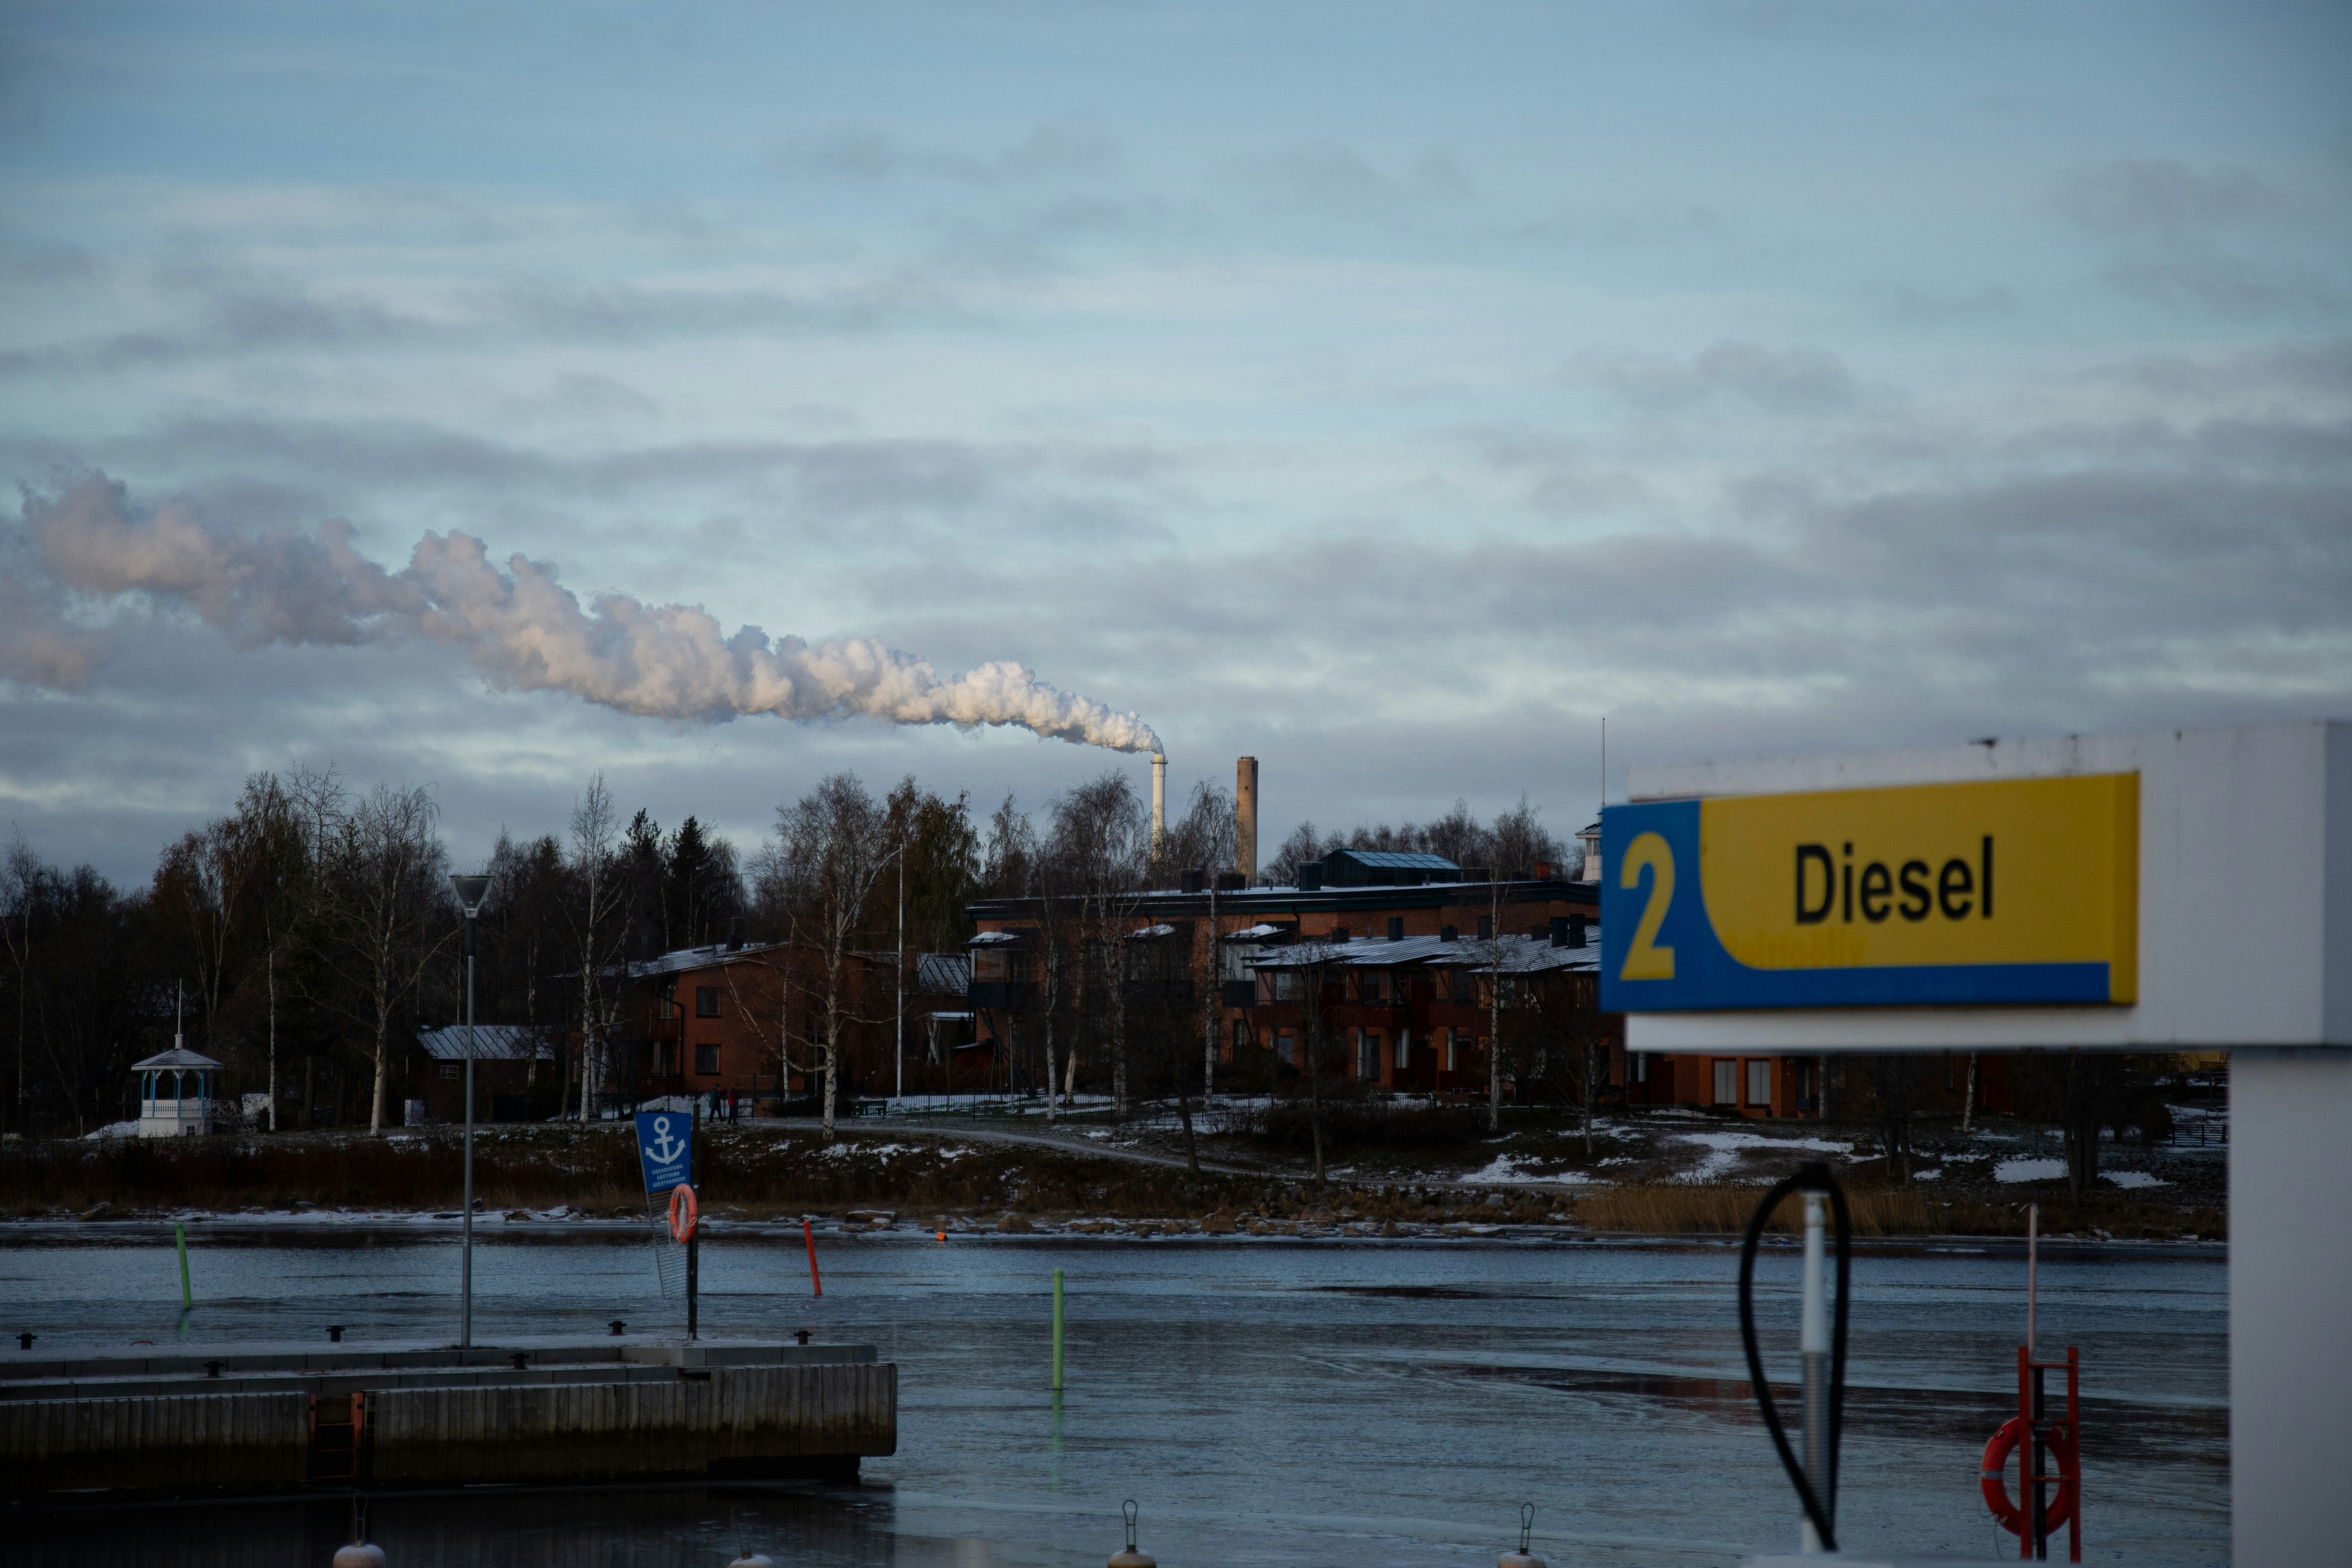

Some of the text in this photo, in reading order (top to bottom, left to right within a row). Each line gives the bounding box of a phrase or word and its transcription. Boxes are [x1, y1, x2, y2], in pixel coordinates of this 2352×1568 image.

[1619, 831, 1675, 981] 2
[1795, 835, 1994, 926] Diesel
[652, 1164, 683, 1175] VIERASSATAMA
[653, 1176, 686, 1188] GUESTHARBOUR
